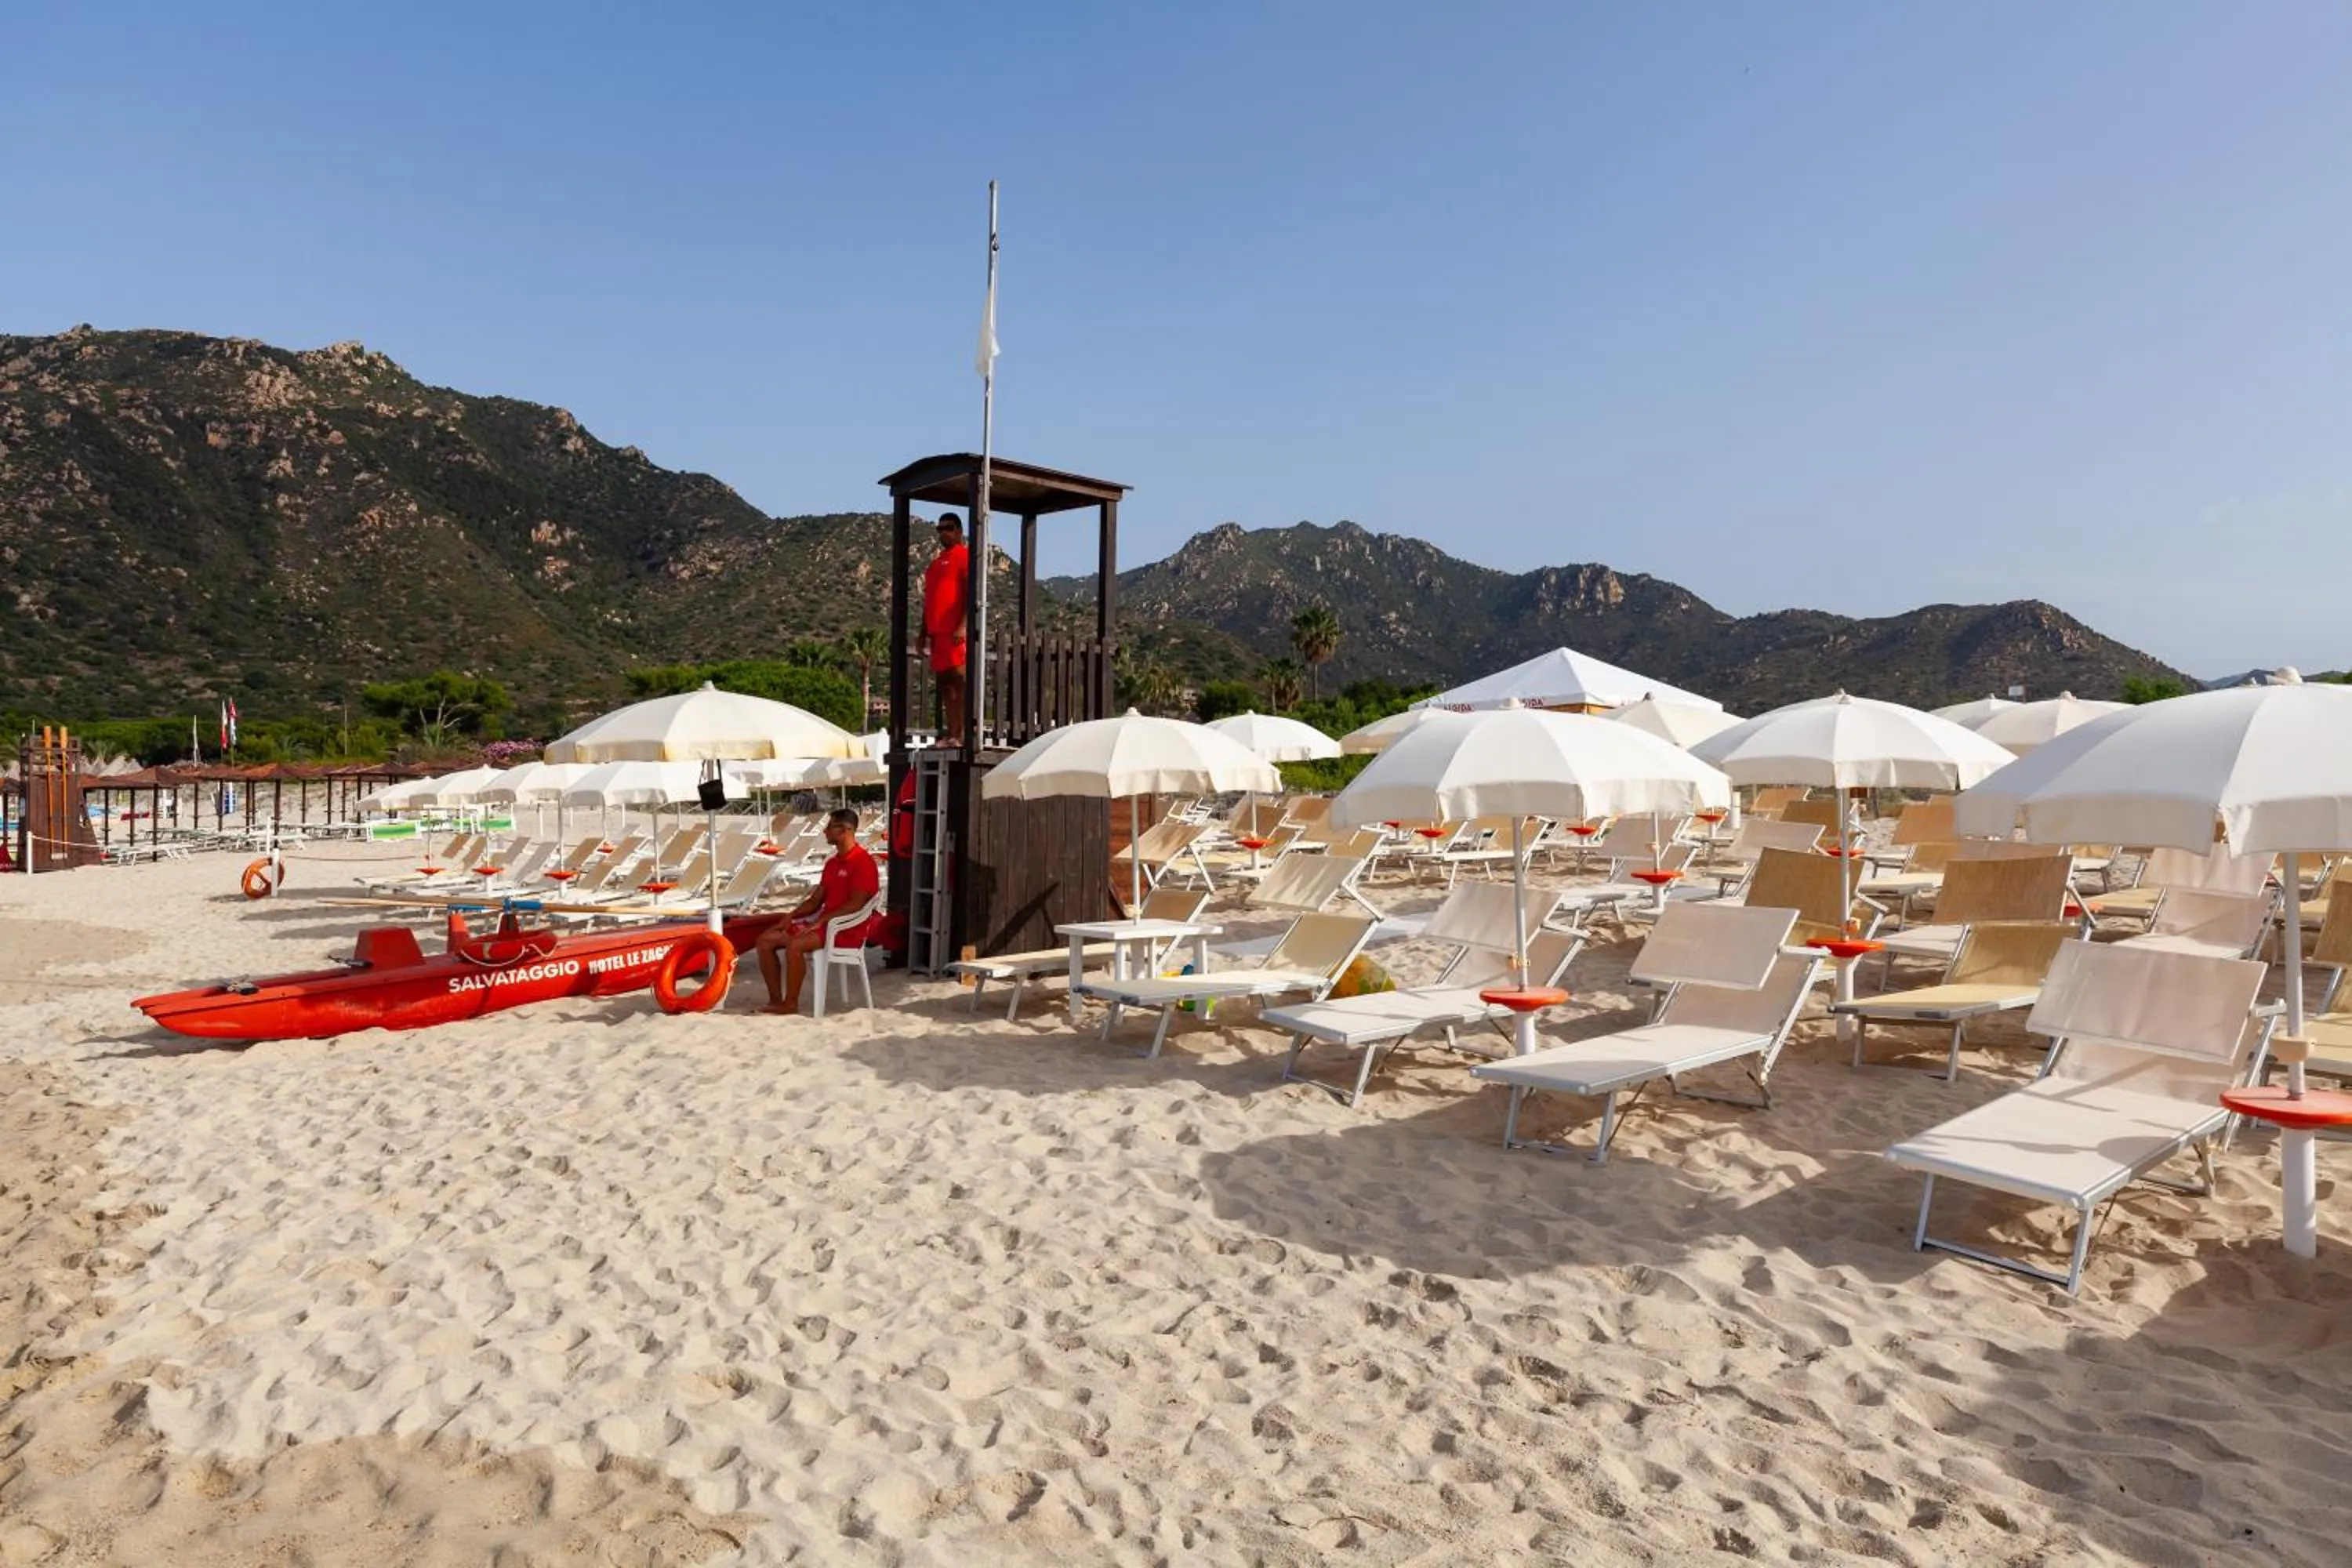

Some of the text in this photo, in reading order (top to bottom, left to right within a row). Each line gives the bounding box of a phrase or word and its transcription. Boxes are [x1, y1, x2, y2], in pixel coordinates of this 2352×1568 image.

[448, 960, 579, 993] SALVATAGGIO
[588, 954, 626, 975] HOTEL
[626, 951, 640, 967] LE
